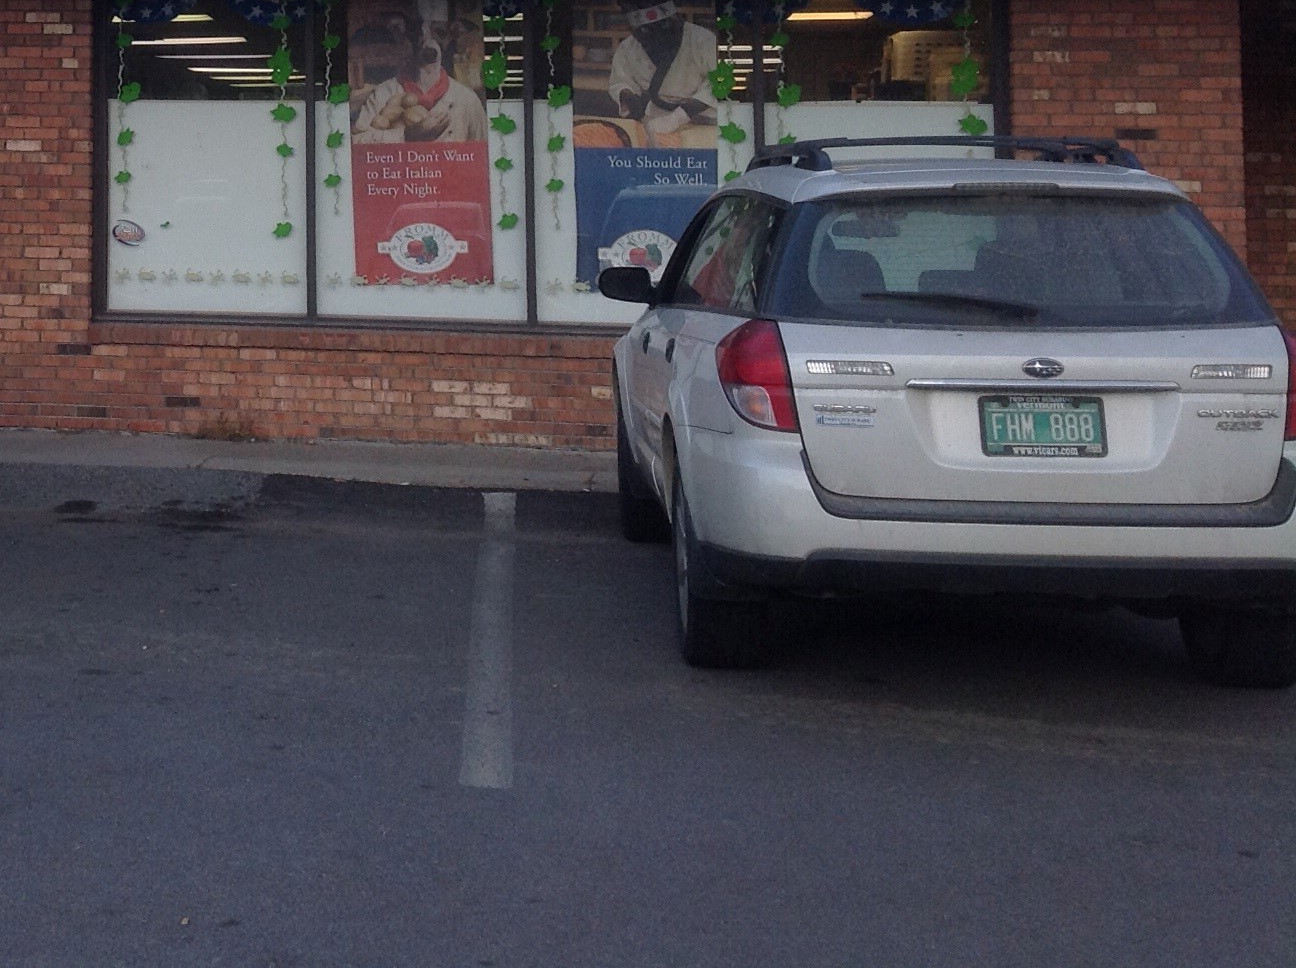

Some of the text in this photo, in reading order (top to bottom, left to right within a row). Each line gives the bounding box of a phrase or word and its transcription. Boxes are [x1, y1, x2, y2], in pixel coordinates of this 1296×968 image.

[366, 149, 475, 164] Even I Don't Want
[607, 155, 707, 169] You Should Eat
[367, 166, 442, 180] to Eat Italian
[654, 172, 707, 186] So Well.
[367, 183, 441, 198] Every Night.
[395, 224, 450, 244] FROMM
[1197, 409, 1280, 419] OUTBACK
[991, 412, 1094, 442] FHM 888
